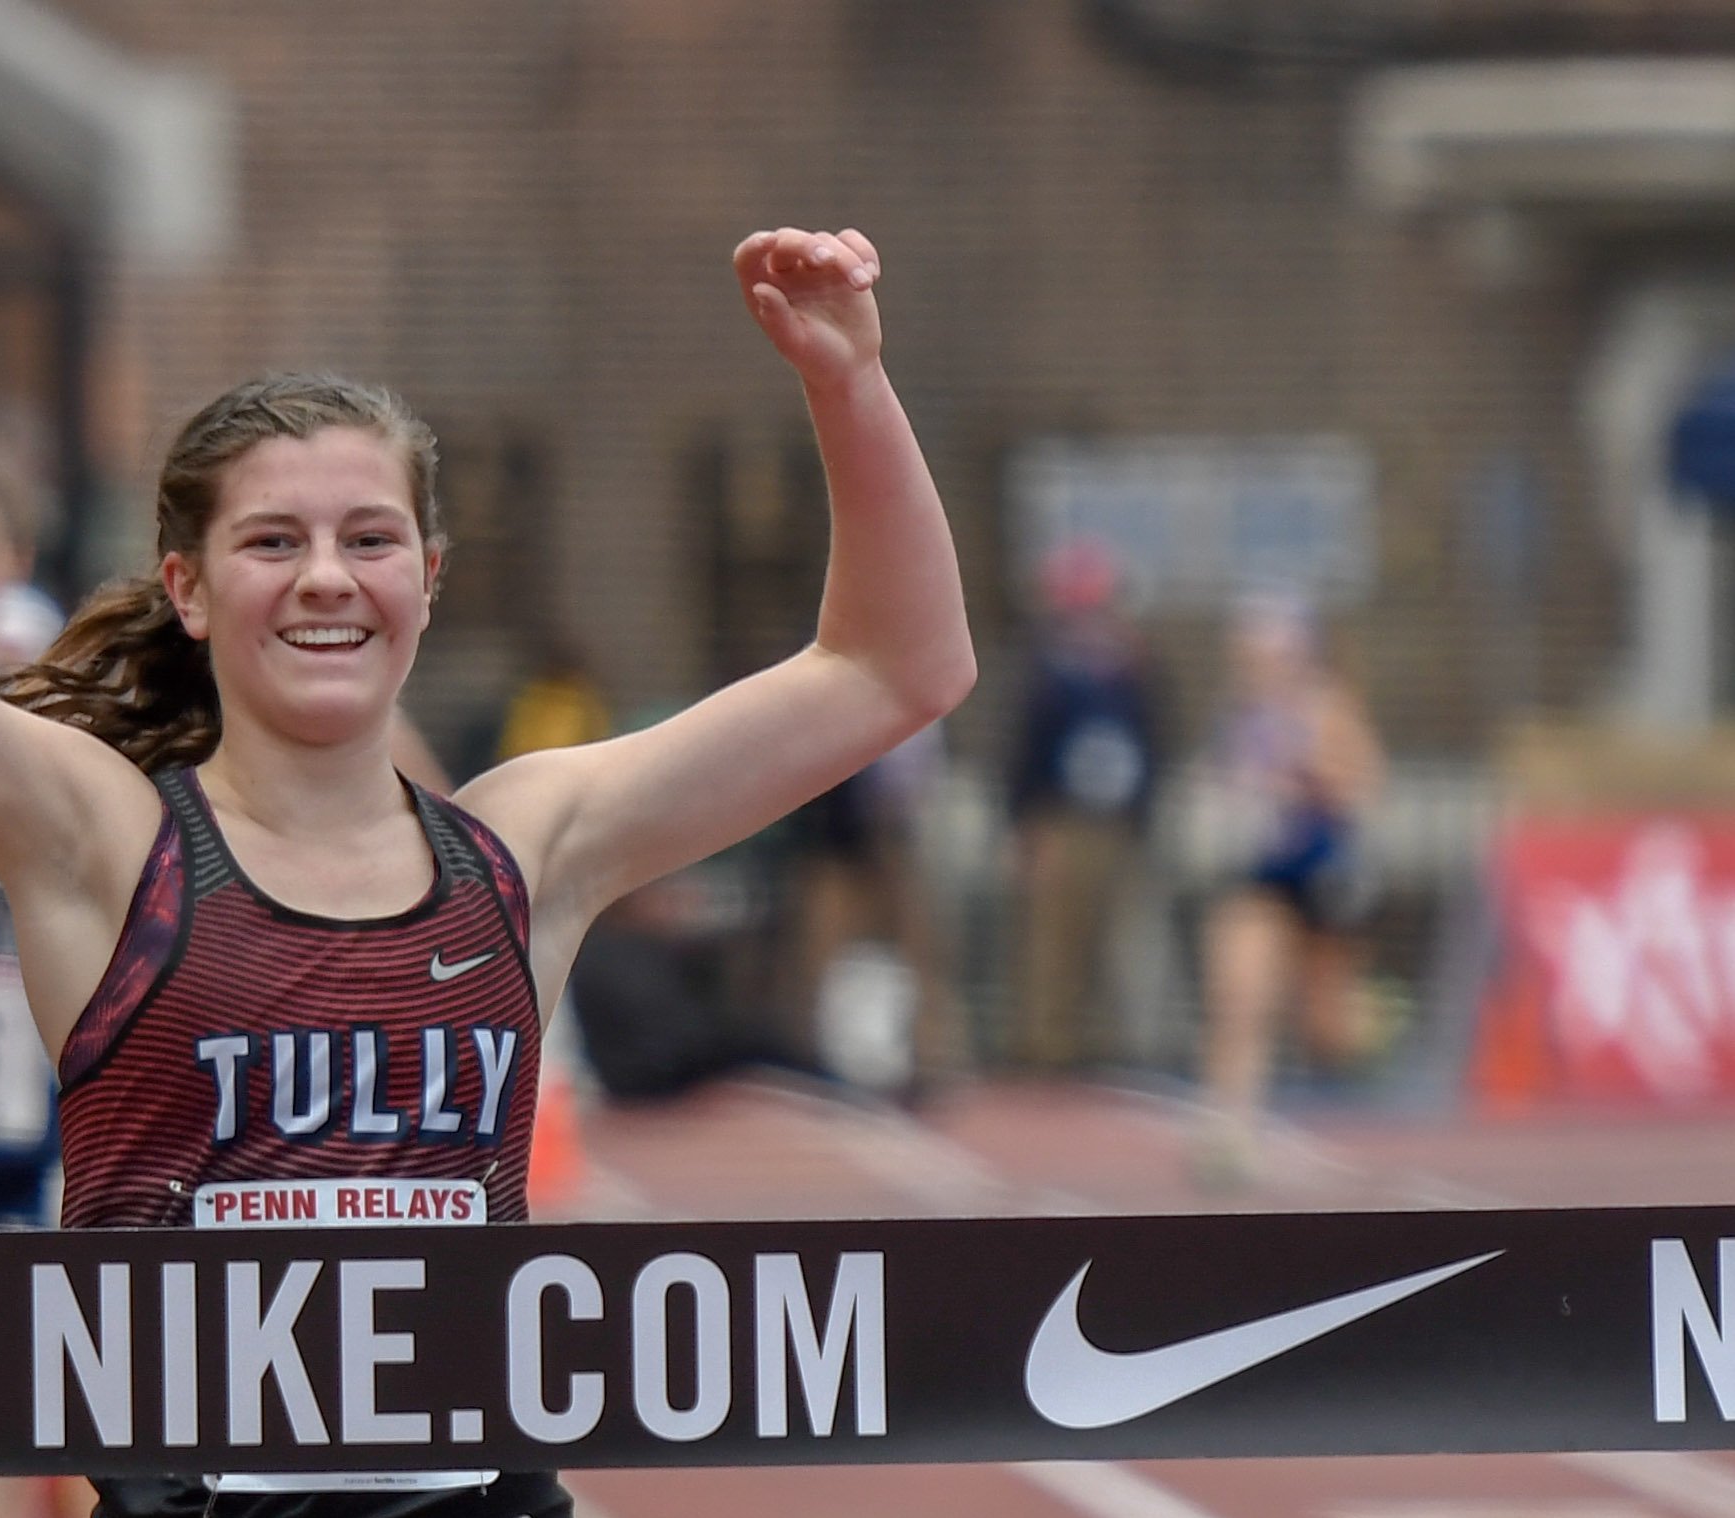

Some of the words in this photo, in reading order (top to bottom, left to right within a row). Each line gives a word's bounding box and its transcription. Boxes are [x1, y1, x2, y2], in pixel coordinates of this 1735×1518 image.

[197, 1027, 519, 1143] TULLY
[214, 1189, 318, 1222] PENN
[336, 1186, 473, 1220] RELAYS
[33, 1253, 886, 1446] NIKE.COM
